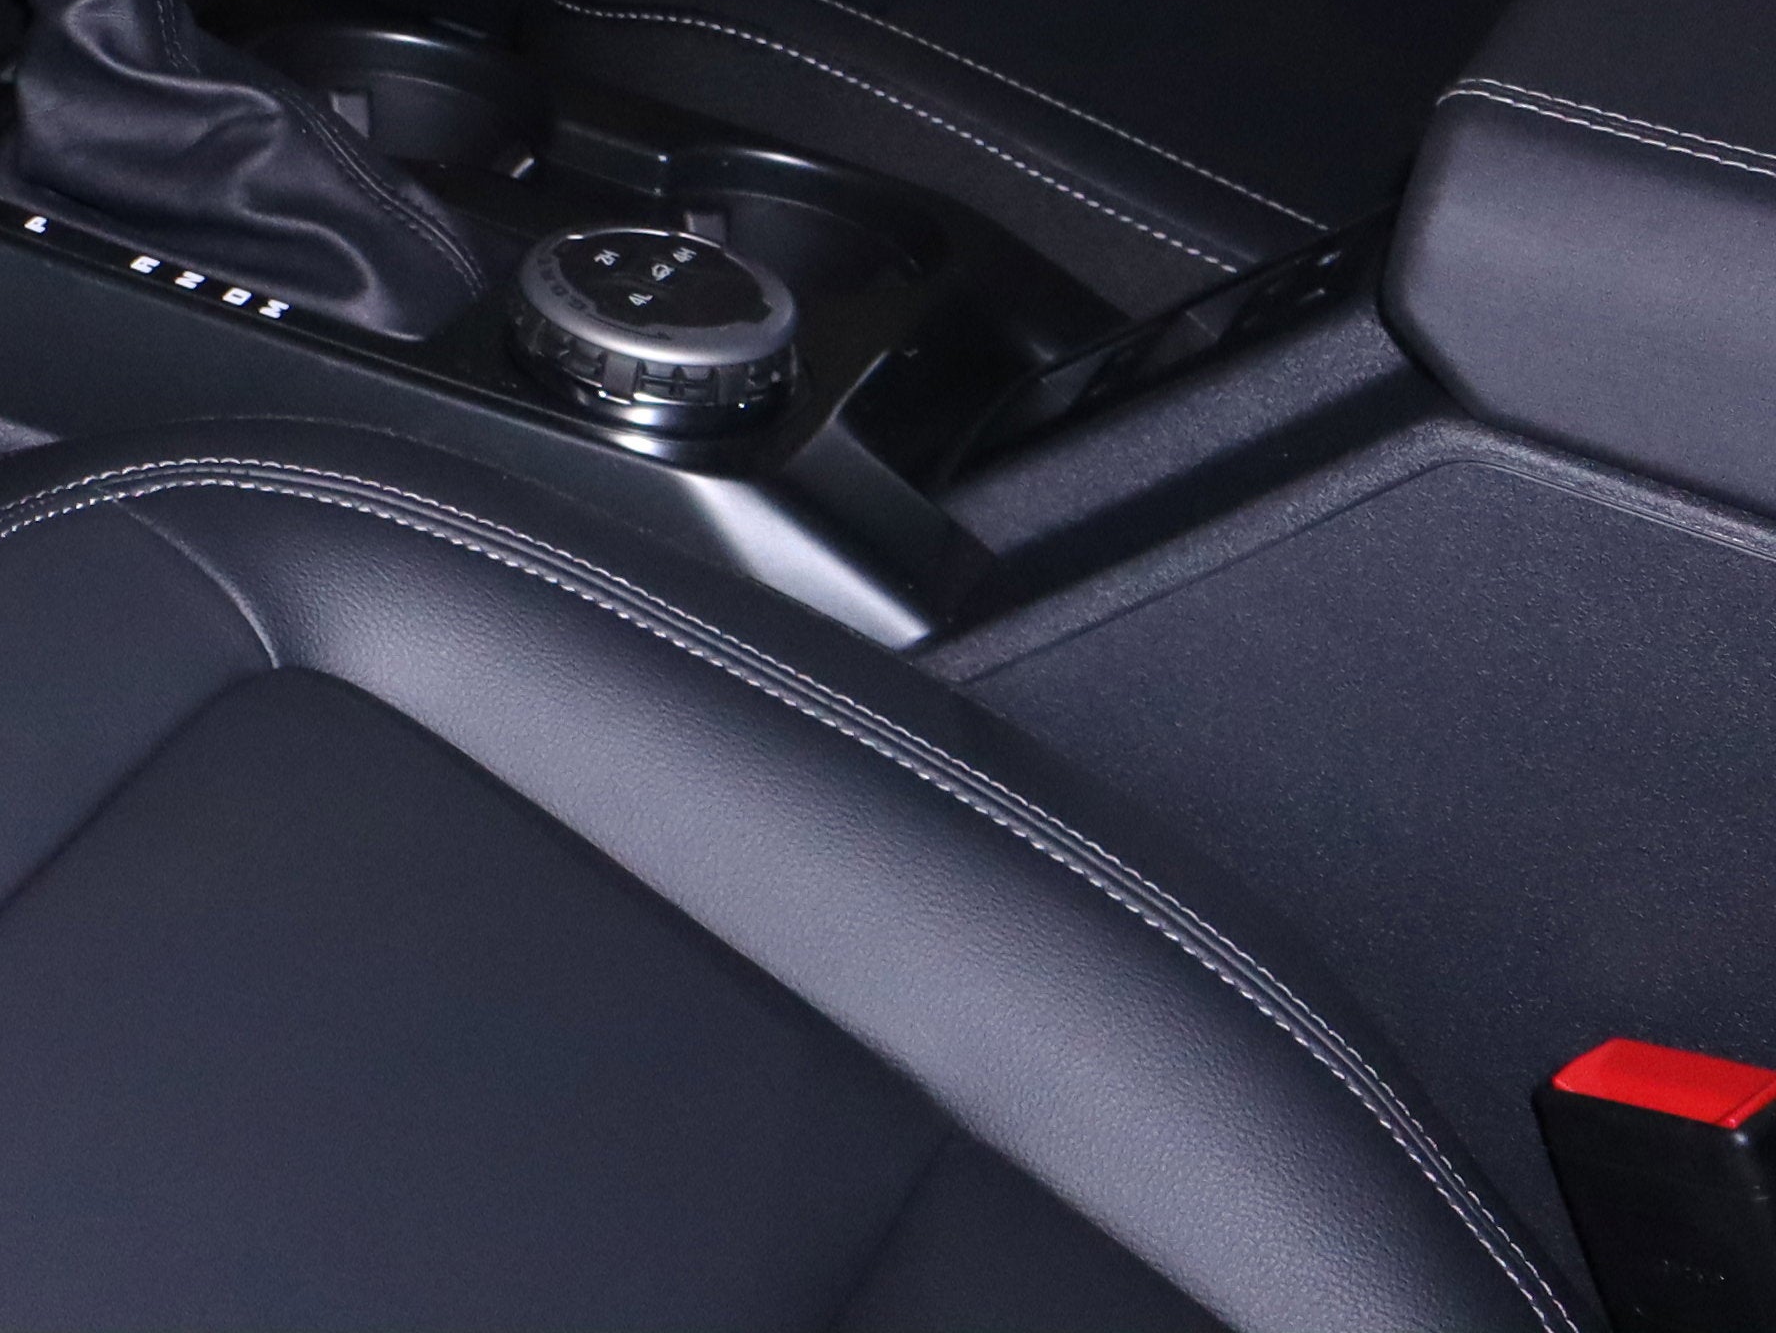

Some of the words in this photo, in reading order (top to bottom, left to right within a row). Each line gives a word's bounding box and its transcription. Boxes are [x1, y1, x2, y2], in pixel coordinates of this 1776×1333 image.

[24, 214, 49, 235] P
[128, 254, 161, 275] R
[174, 270, 207, 290] N
[258, 298, 291, 320] M
